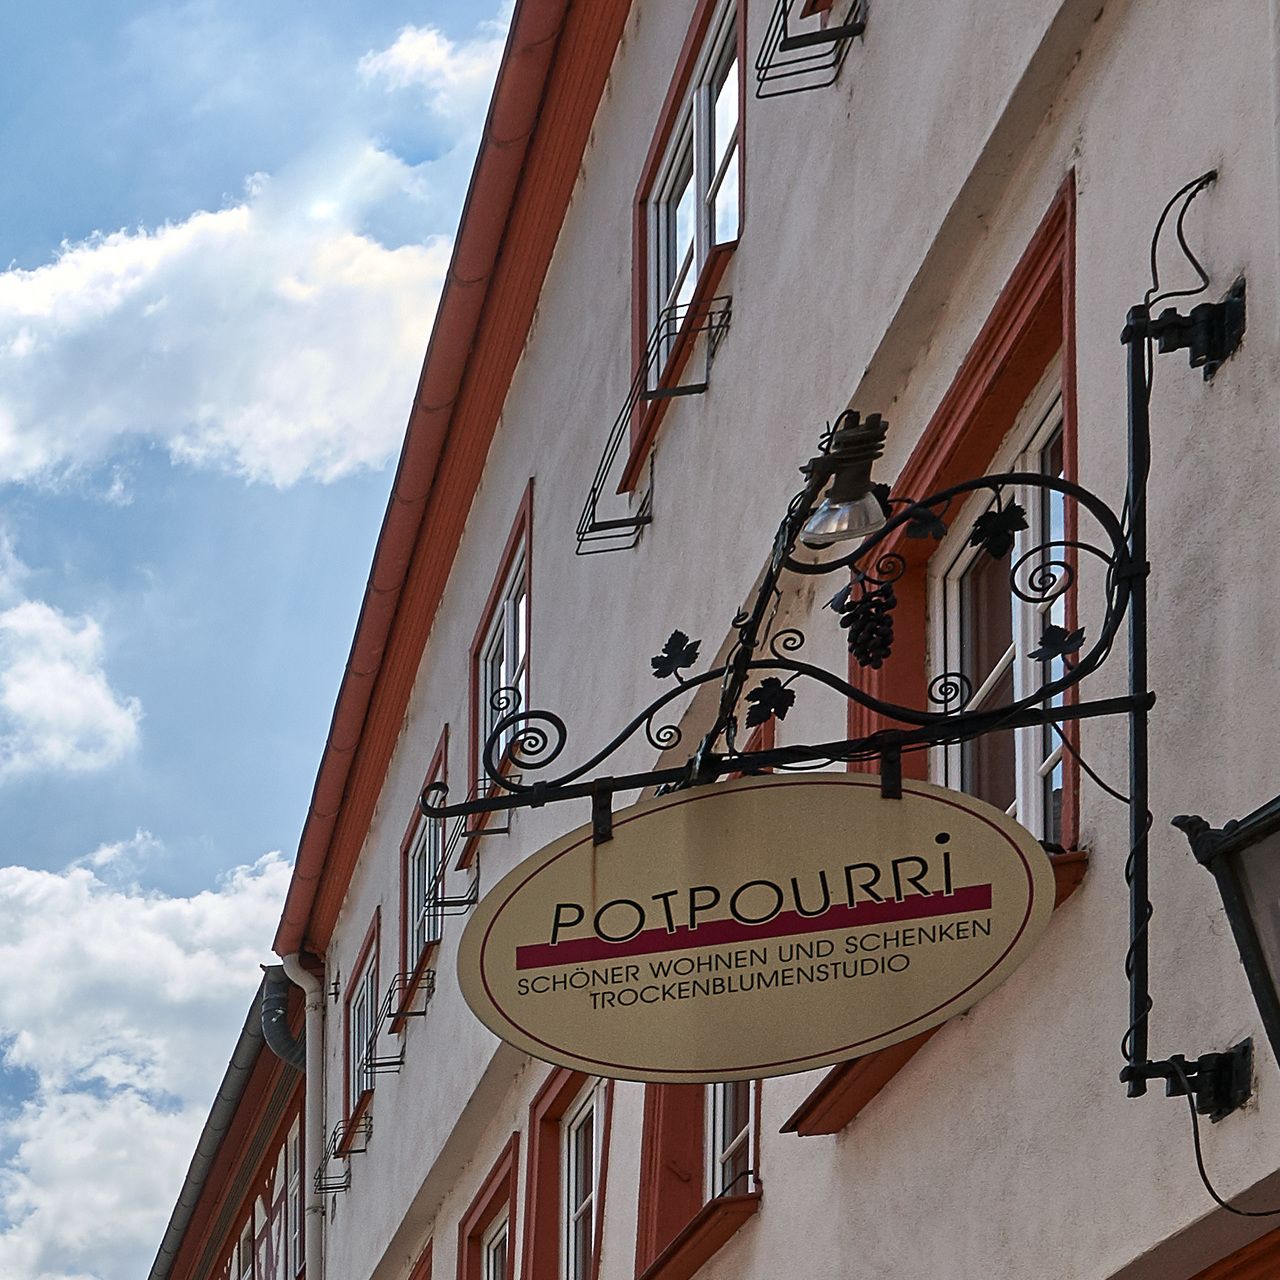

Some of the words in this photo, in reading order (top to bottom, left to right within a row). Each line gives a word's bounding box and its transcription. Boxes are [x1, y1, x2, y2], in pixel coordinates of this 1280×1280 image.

[517, 964, 640, 997] SCHÖNER
[649, 947, 768, 980] WOHNEN
[778, 939, 835, 963] UND
[844, 918, 992, 954] SCHENKEN
[589, 953, 911, 1011] TROCKENBLUMENSTUDIO
